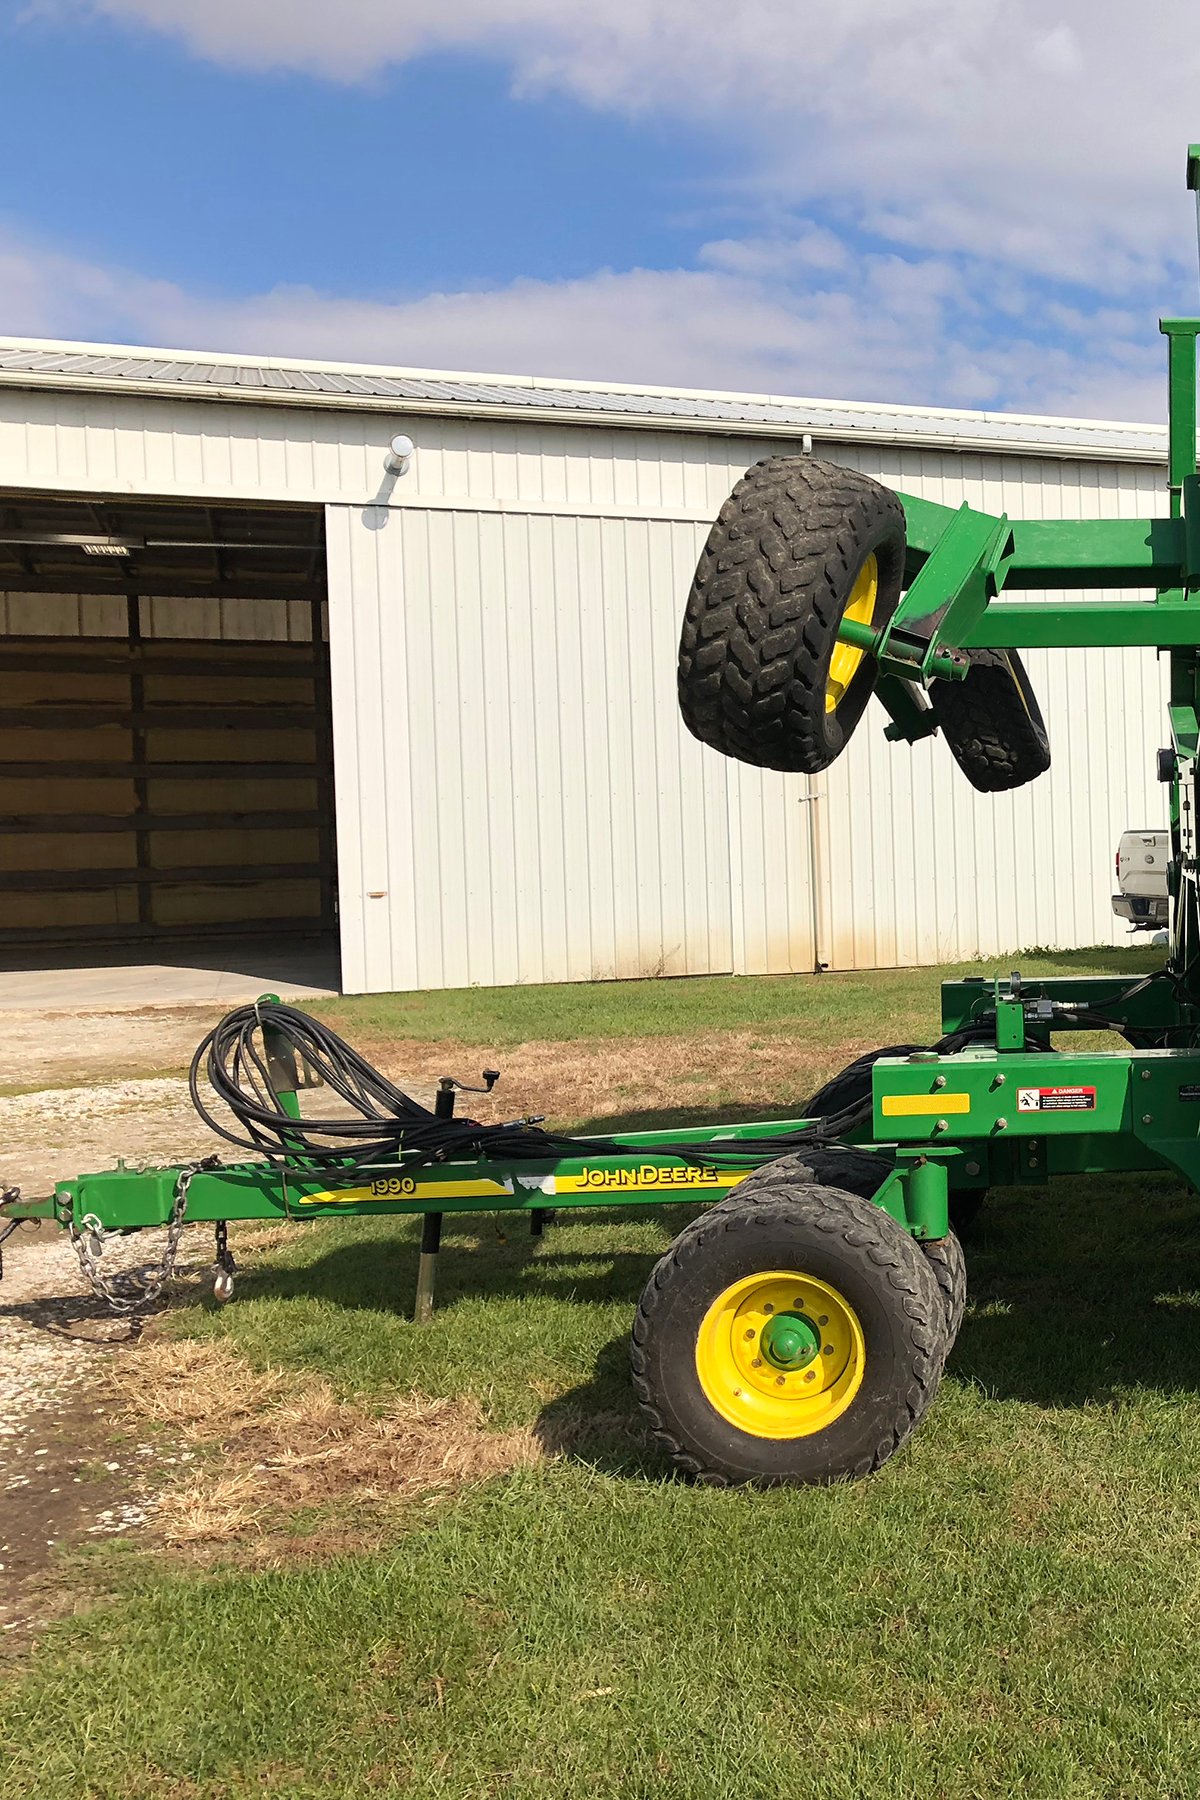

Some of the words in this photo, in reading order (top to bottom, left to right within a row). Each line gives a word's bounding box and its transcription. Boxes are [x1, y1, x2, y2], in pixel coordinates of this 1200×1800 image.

[576, 1167, 637, 1186] JOHN
[639, 1165, 718, 1184] DEERE
[371, 1177, 415, 1195] 1990
